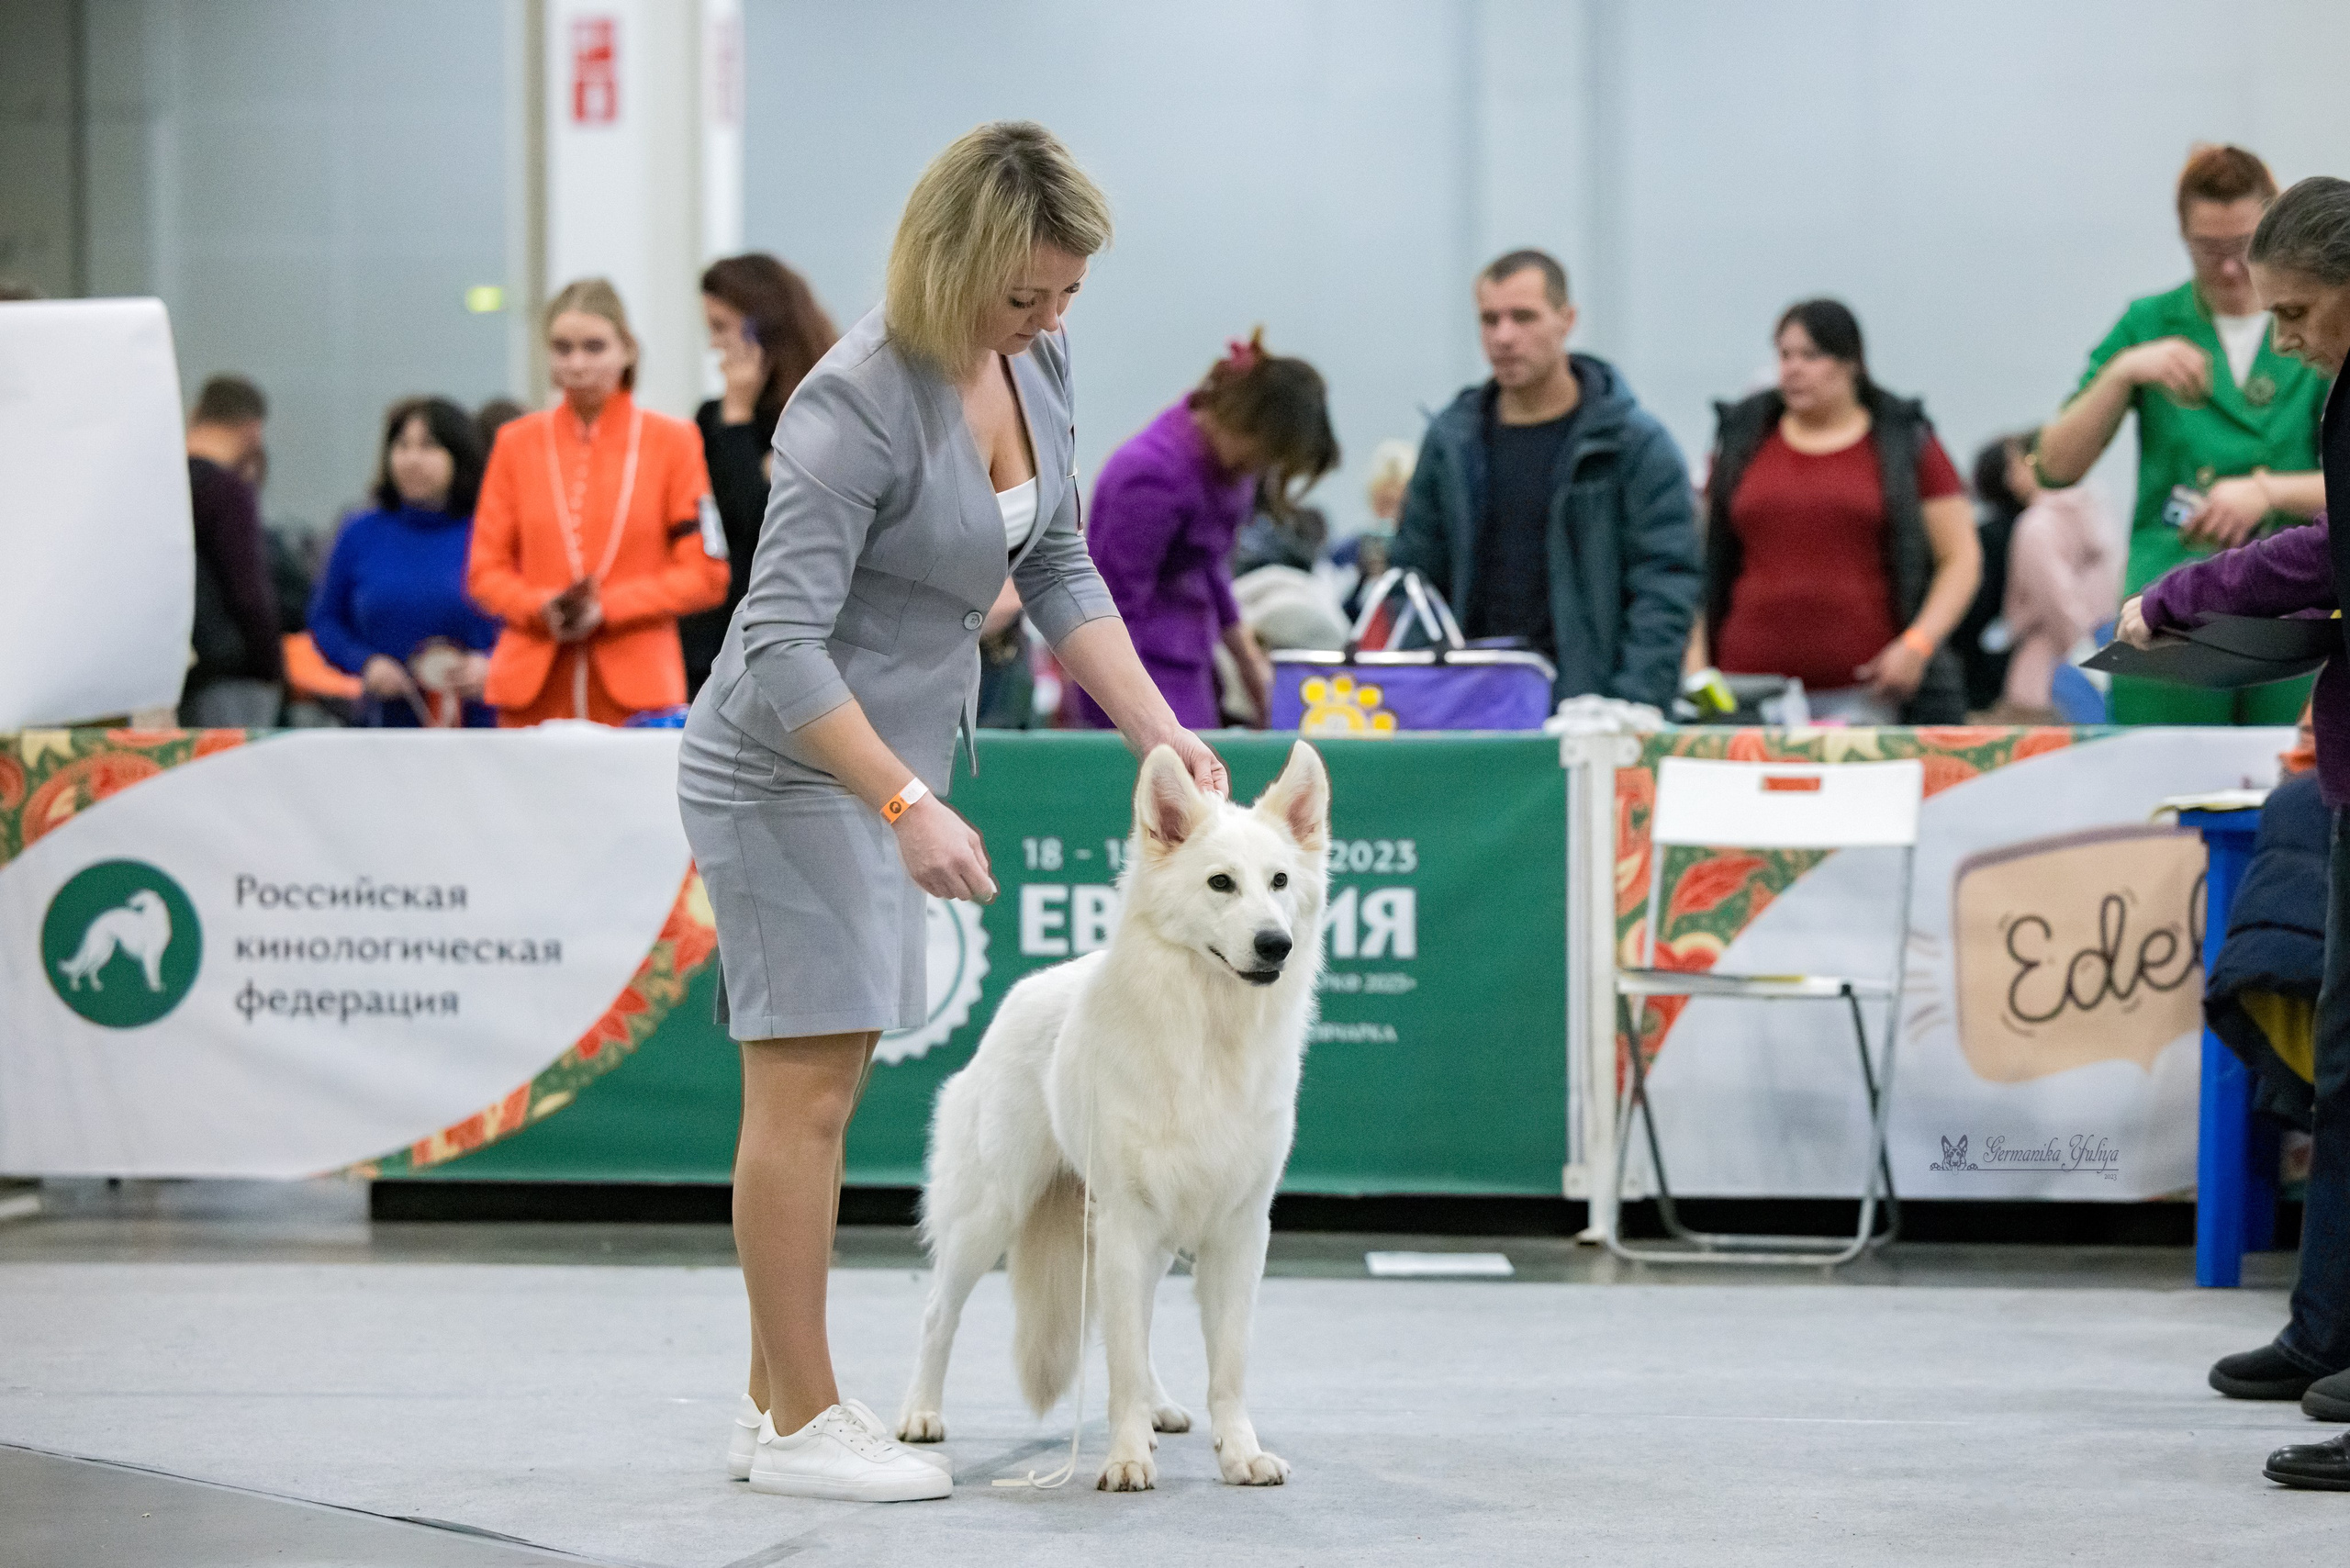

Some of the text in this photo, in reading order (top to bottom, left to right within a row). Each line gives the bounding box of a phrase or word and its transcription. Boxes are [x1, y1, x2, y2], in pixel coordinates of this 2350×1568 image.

[1023, 837, 1063, 870] 18
[1329, 839, 1418, 873] 2023
[236, 873, 466, 909] Российская
[236, 937, 562, 963] кинологическая
[236, 979, 458, 1024] федерация
